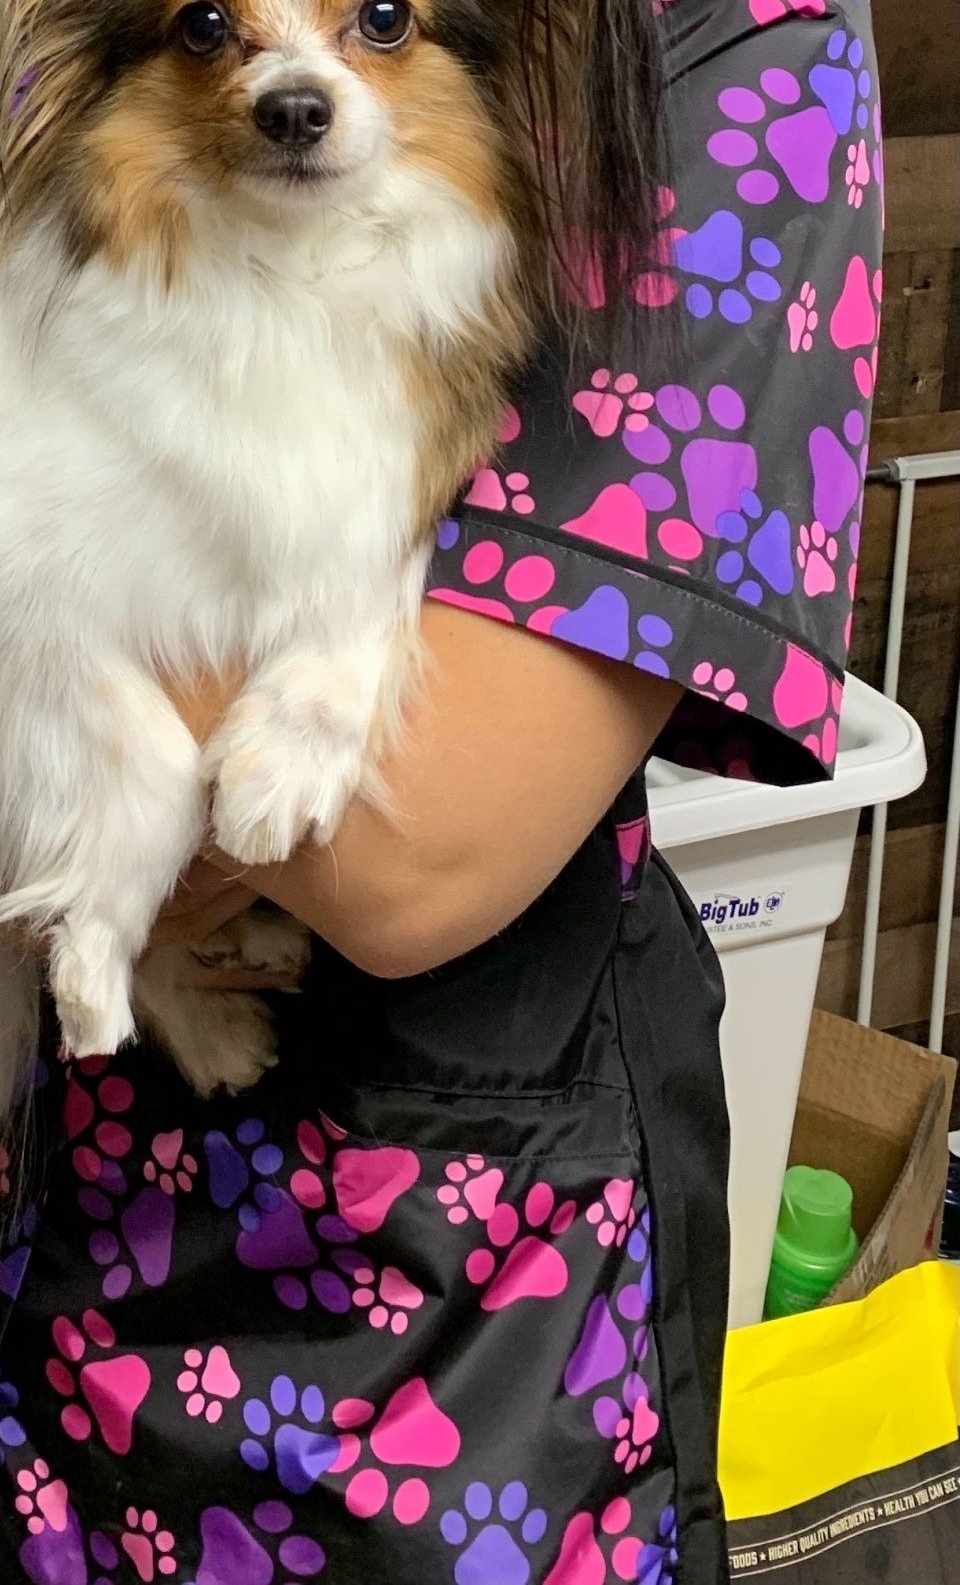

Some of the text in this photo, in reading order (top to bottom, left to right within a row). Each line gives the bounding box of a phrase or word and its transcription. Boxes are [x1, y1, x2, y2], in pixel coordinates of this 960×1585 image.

[768, 1539, 800, 1562] HIGHER
[799, 1526, 830, 1554] QUALITY
[829, 1507, 876, 1538] INGREDIENTS
[884, 1494, 915, 1517] HEALTH
[916, 1489, 929, 1506] YOU
[929, 1483, 945, 1500] CAN
[944, 1477, 958, 1494] SEE
